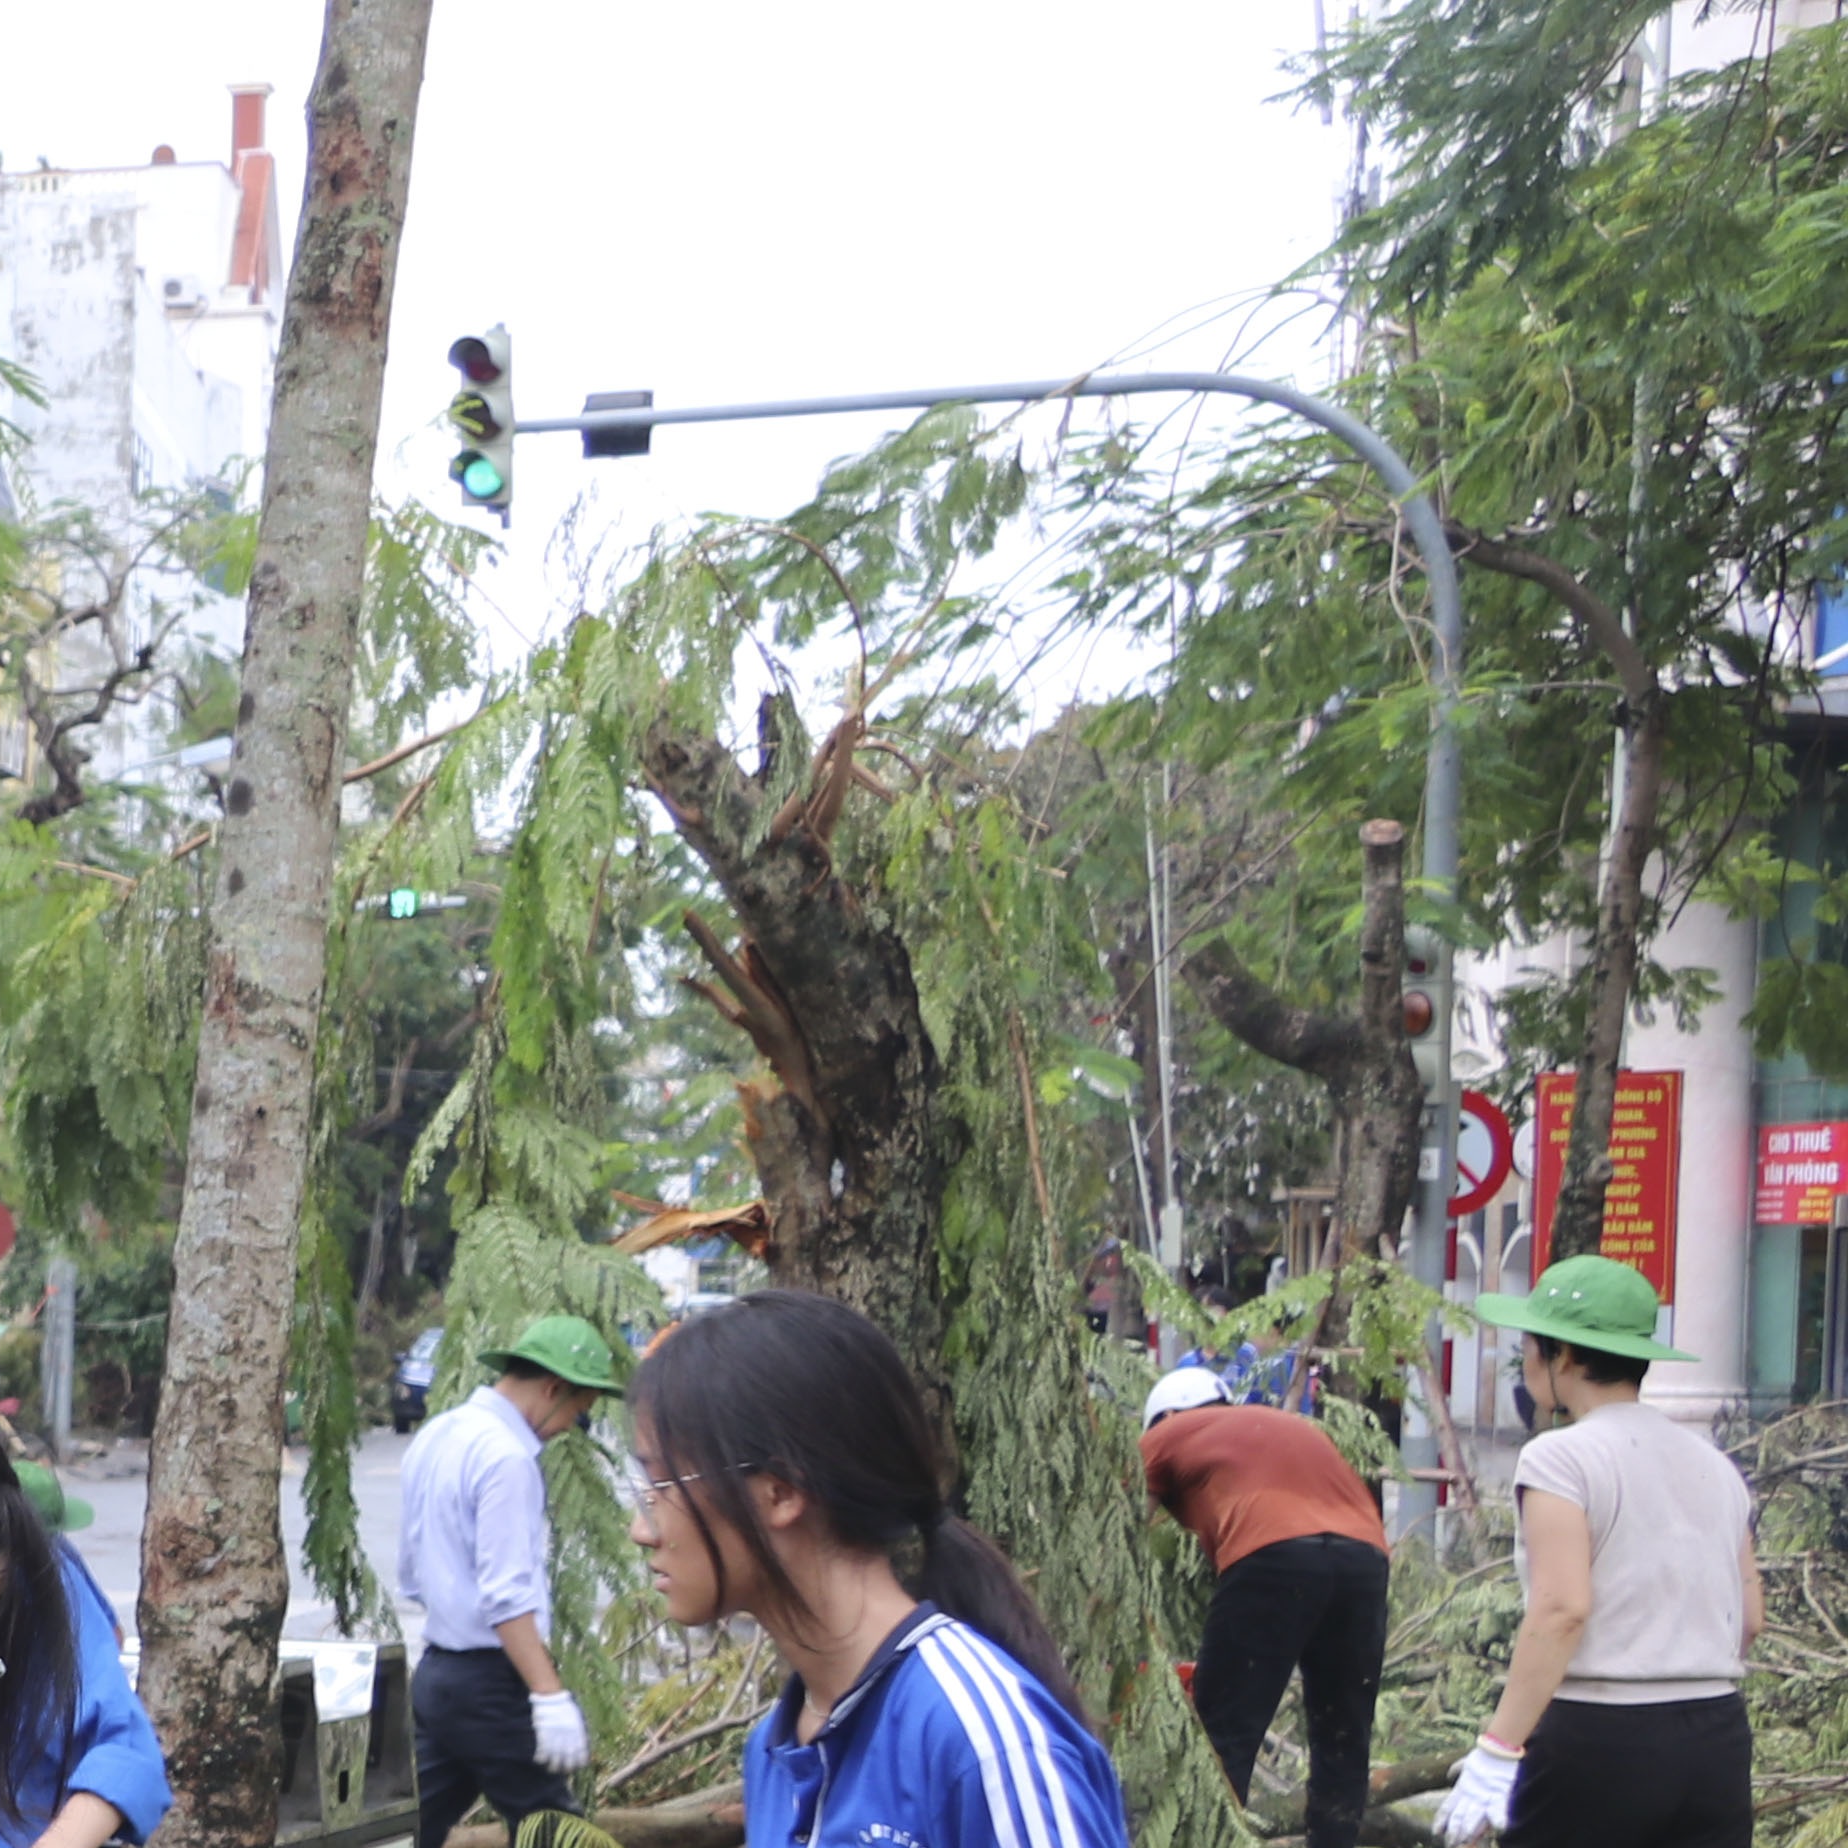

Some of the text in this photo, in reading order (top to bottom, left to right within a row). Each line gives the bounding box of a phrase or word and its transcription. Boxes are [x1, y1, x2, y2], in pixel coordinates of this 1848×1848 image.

[1768, 1126, 1832, 1155] CHO THUÊ
[1764, 1158, 1840, 1186] VĂN PHÒNG
